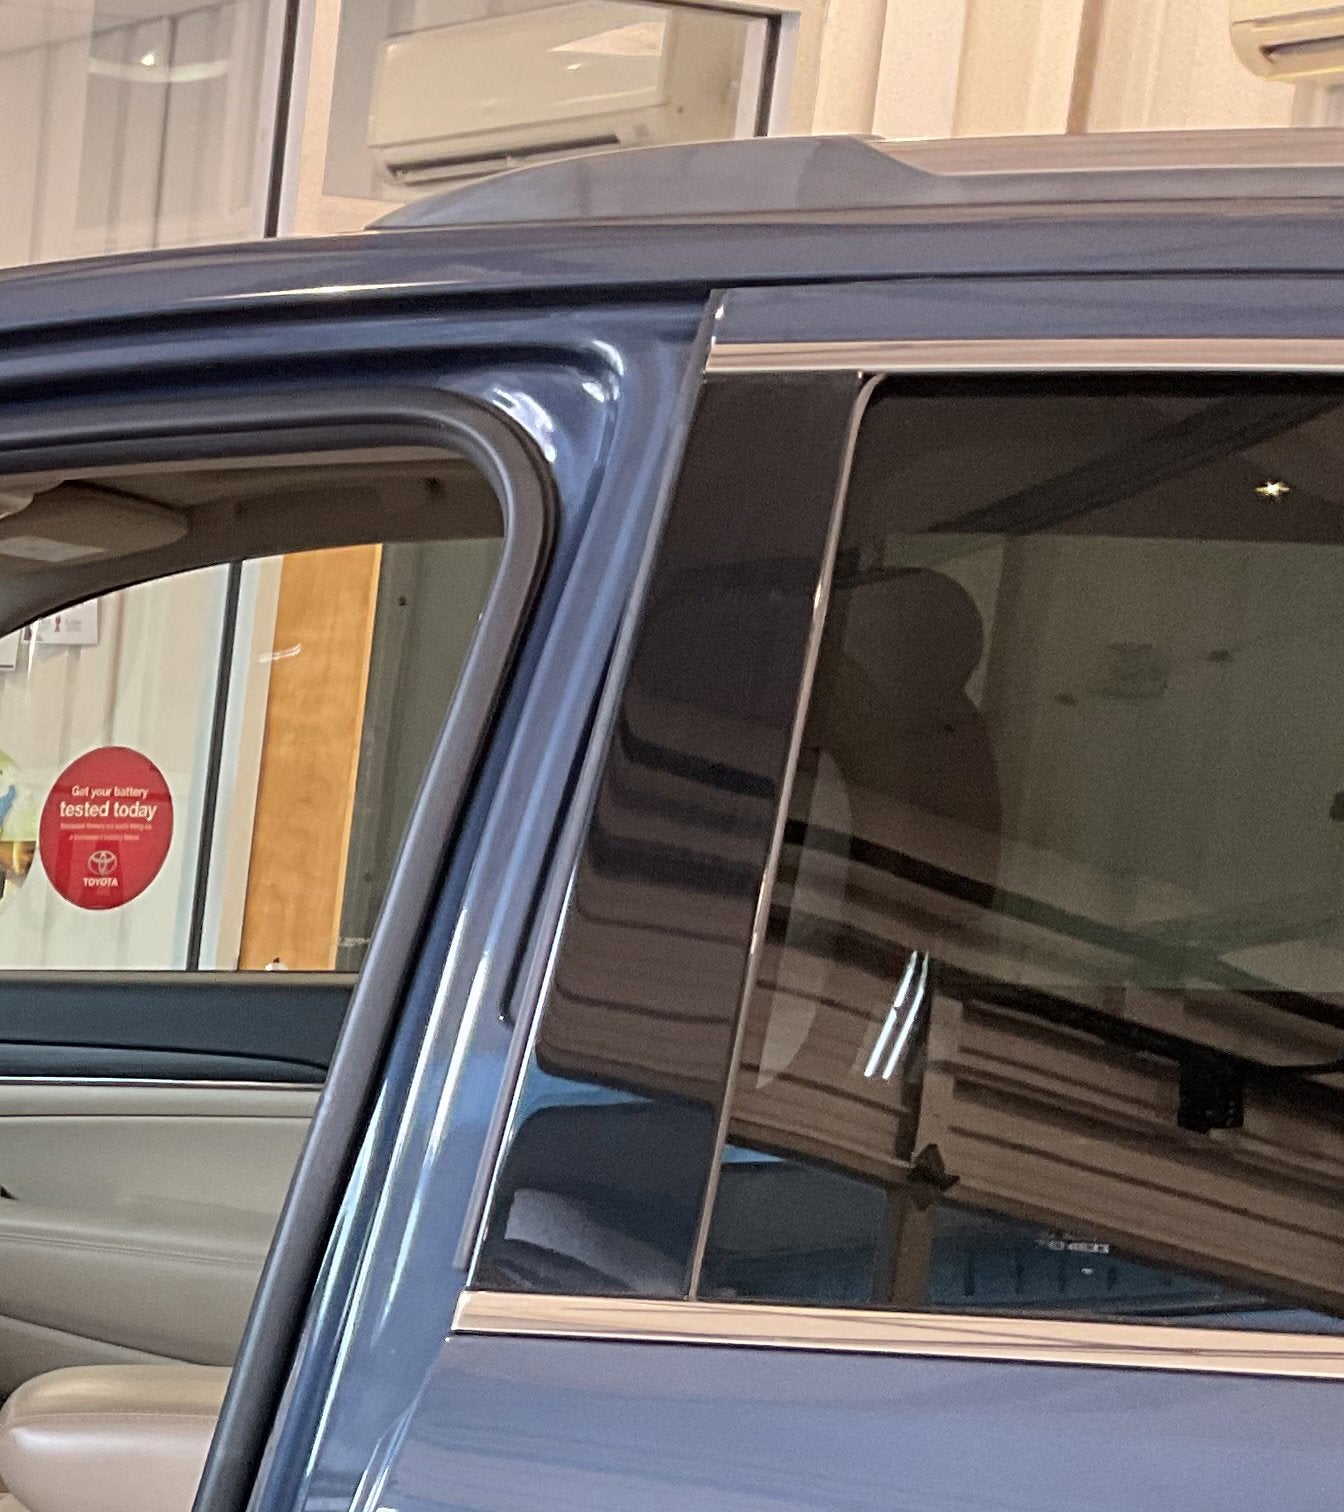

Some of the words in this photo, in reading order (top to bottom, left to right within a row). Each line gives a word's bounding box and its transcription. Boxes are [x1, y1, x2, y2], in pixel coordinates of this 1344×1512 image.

[71, 785, 90, 797] Get
[91, 787, 112, 799] your
[114, 786, 150, 800] battery
[59, 800, 110, 817] tested
[113, 801, 157, 821] today
[82, 877, 119, 887] TOYOTA
